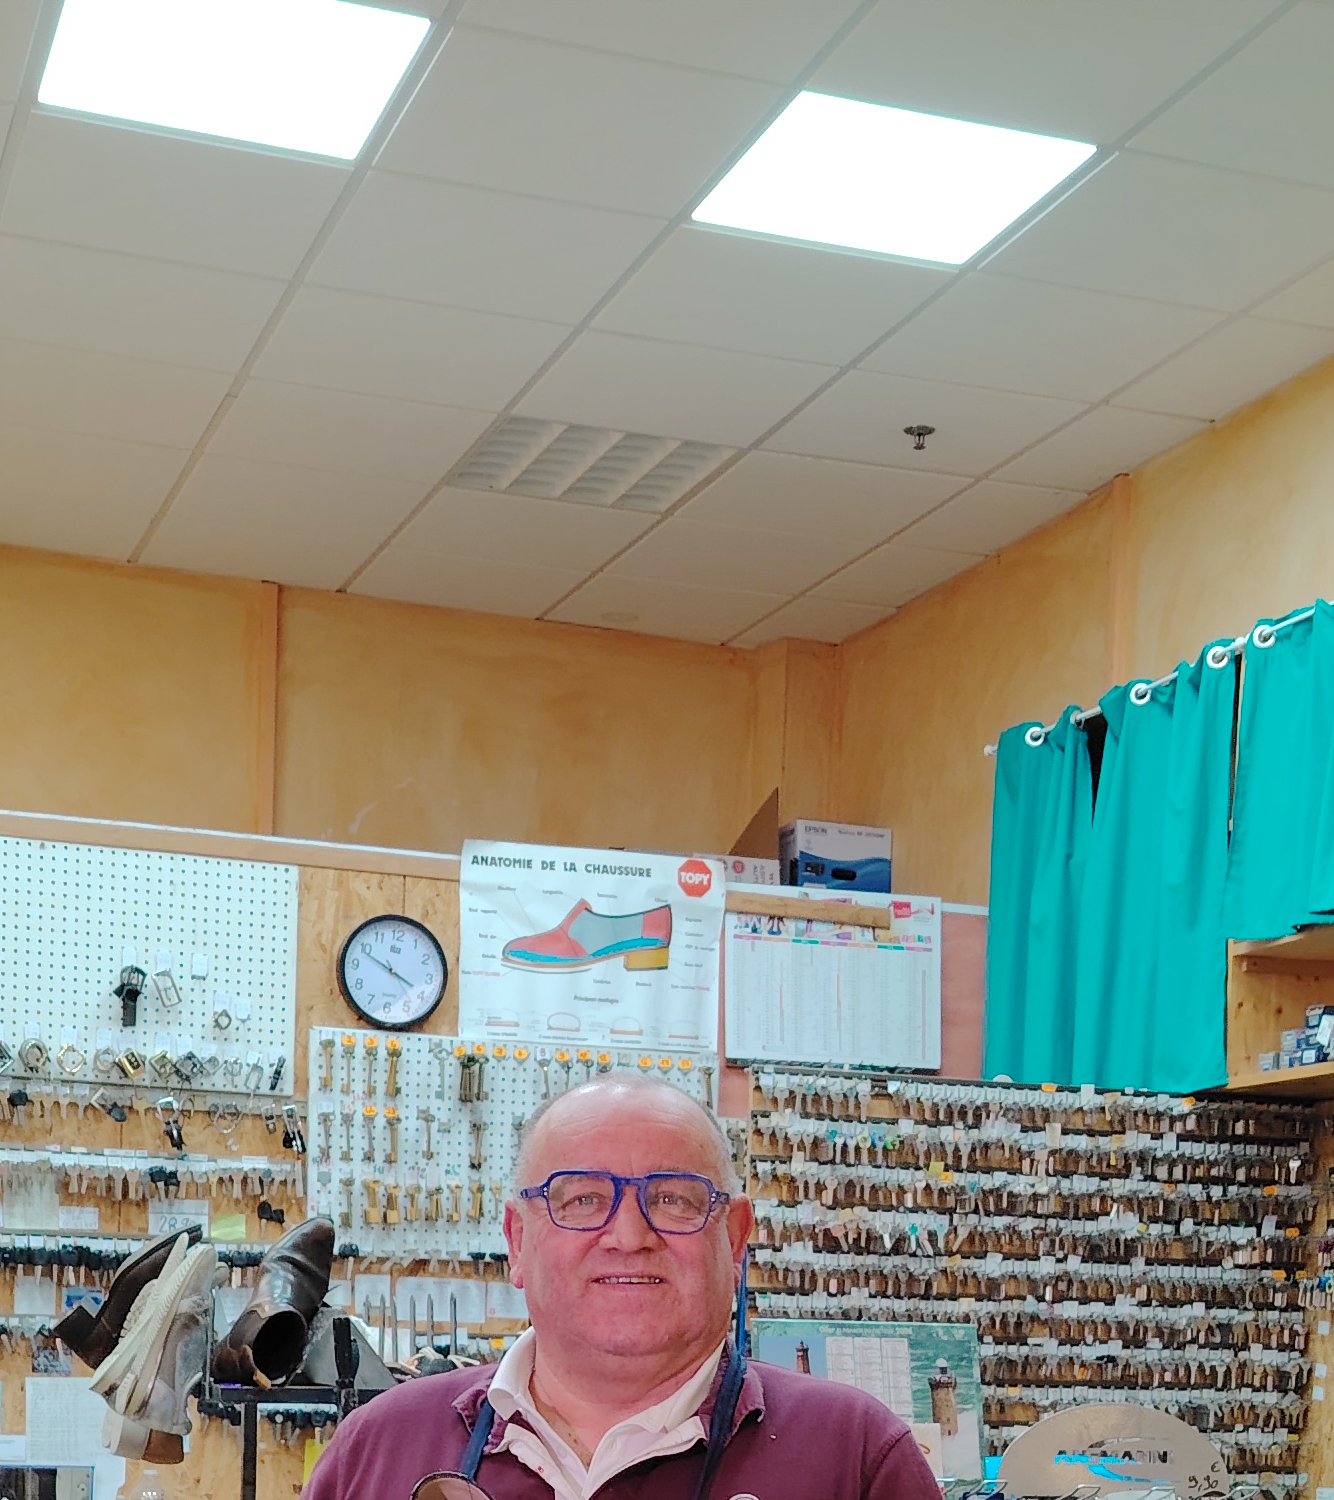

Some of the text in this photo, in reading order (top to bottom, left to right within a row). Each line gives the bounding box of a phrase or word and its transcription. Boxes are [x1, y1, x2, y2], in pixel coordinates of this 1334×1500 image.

[471, 855, 652, 878] ANATOMIE DE LA CHAUSSURE
[680, 871, 710, 885] TOPY
[374, 931, 385, 944] 11
[390, 928, 405, 942] 12
[360, 942, 373, 955] 10
[412, 938, 418, 950] 1
[351, 958, 359, 970] 9
[421, 953, 430, 966] 2
[355, 978, 364, 990] 8
[425, 973, 434, 985] 3
[367, 994, 376, 1005] 7
[402, 1000, 411, 1012] 5
[382, 1002, 391, 1015] 6
